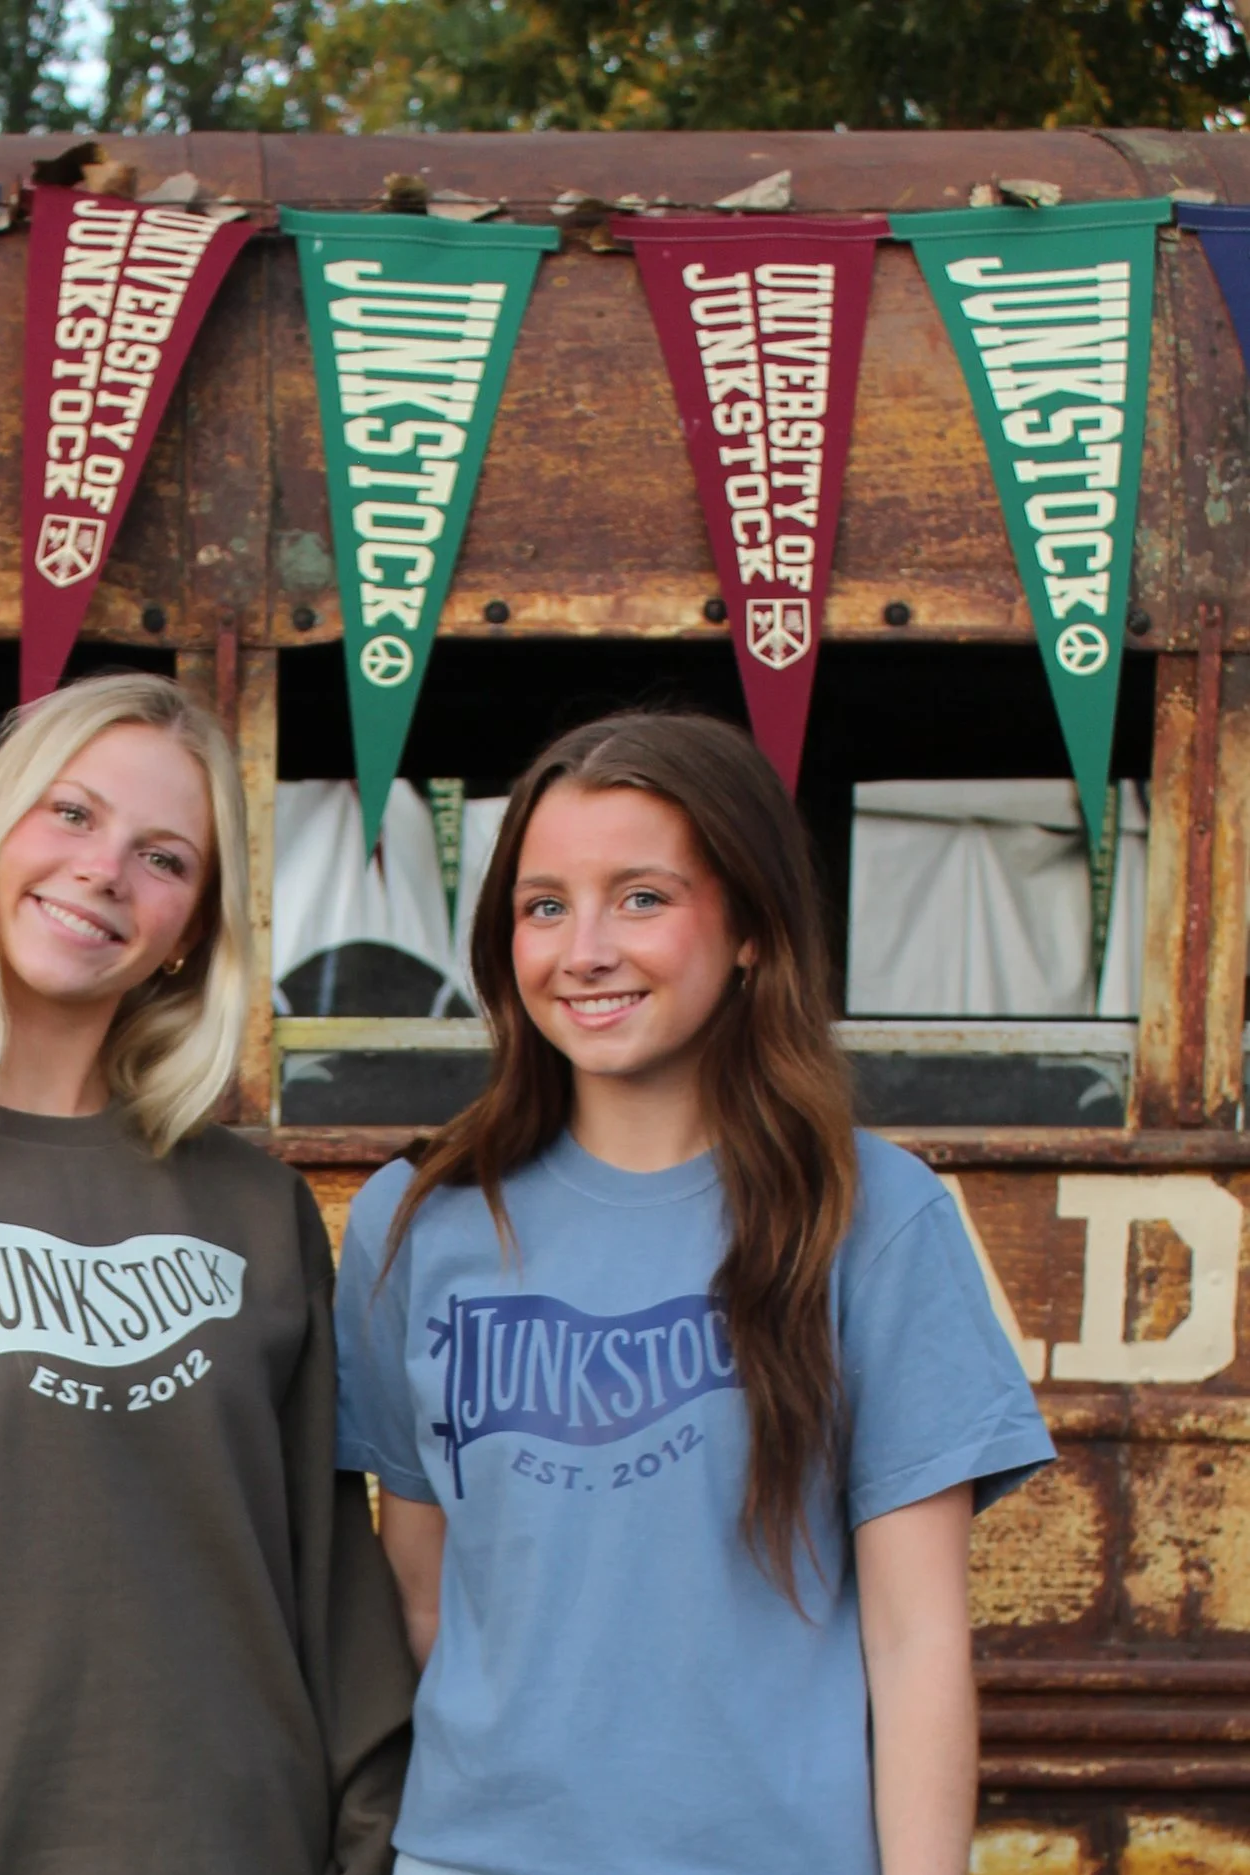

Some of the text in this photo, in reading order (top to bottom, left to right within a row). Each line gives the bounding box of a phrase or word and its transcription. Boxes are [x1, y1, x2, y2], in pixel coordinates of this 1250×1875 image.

[44, 200, 137, 500] JUNKSTOCK
[78, 208, 222, 515] UNIVERSITY OF
[323, 259, 507, 631] JUNKSTOCK
[681, 263, 775, 585] JUNKSTOCK
[754, 263, 835, 591] UNIVERSITY OF
[945, 257, 1132, 619] JUNKSTOCK
[29, 1349, 212, 1411] EST. 2012
[938, 1173, 1243, 1384] D
[511, 1423, 704, 1491] EST. 2012
